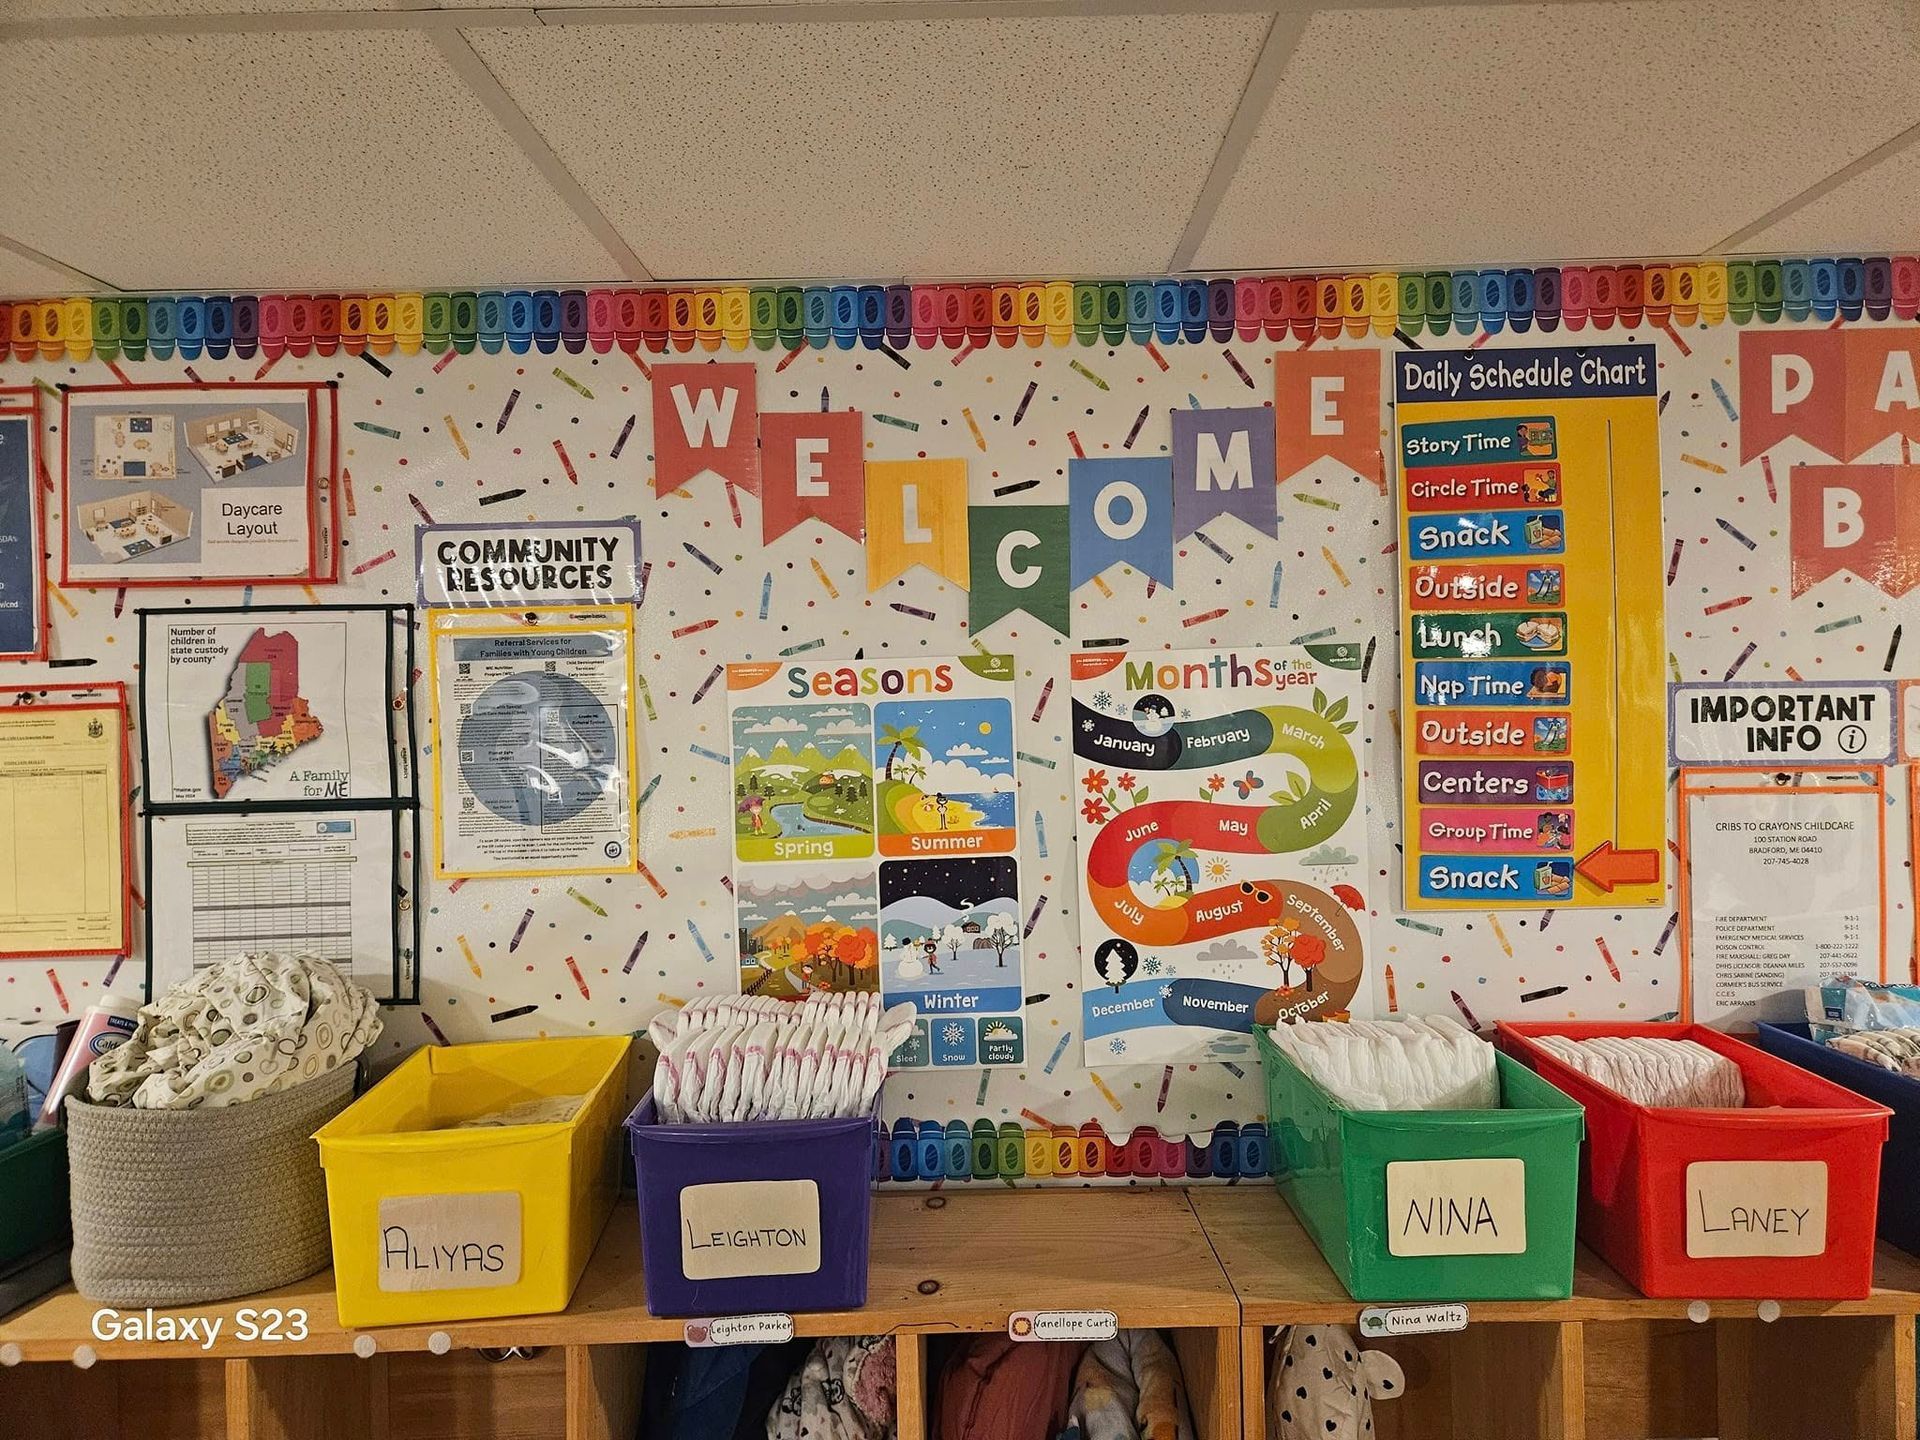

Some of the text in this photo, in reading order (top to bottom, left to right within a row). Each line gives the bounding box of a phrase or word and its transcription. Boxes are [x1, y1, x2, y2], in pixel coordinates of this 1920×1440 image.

[1404, 356, 1647, 397] Daily Schedule Chart
[1406, 433, 1511, 456] Story Time
[1411, 477, 1519, 498] Circle Time
[222, 503, 283, 519] Daycare
[227, 521, 278, 538] Layout
[1418, 520, 1511, 551] Snack
[437, 536, 619, 565] COMMUNITY
[447, 565, 612, 592] RESOURCES
[1415, 568, 1519, 600] Outside
[170, 627, 216, 636] Number of
[170, 637, 216, 645] children in
[526, 638, 559, 646] Services
[1420, 616, 1502, 648] Lunch
[170, 656, 180, 664] by
[194, 646, 229, 655] custody
[480, 650, 512, 658] Families
[531, 649, 555, 657] Young
[556, 648, 587, 656] Children
[787, 663, 954, 699] Seasons
[1125, 653, 1273, 691] Months
[1274, 659, 1287, 671] of
[1292, 658, 1312, 671] the
[1275, 670, 1318, 691] year
[1420, 675, 1524, 697] Nap Time
[1690, 694, 1876, 723] IMPORTANT
[1186, 728, 1251, 749] February
[1281, 723, 1327, 750] March
[1421, 720, 1526, 746] Outside
[1747, 724, 1822, 753] INFO
[1093, 733, 1157, 756] January
[289, 770, 349, 783] A Family
[1423, 770, 1529, 796] Centers
[304, 782, 348, 798] for ME
[1299, 798, 1333, 831] April
[1124, 820, 1159, 842] June
[1219, 818, 1249, 836] May
[1428, 822, 1533, 842] Group Time
[1715, 821, 1855, 831] CRIBS TO CRAYONS CHILDCARE
[774, 839, 834, 856] Spring
[911, 834, 983, 851] Summer
[1749, 847, 1788, 855] BRADFORD,
[1429, 863, 1520, 890] Snack
[1113, 899, 1145, 926] July
[1195, 899, 1244, 923] August
[1286, 893, 1346, 952] September
[924, 993, 979, 1009] Winter
[1091, 997, 1156, 1018] December
[1183, 994, 1249, 1014] November
[1277, 990, 1330, 1023] October
[942, 1054, 966, 1062] Snow
[988, 1052, 1015, 1061] cloudy
[989, 1043, 1013, 1053] Partly
[896, 1055, 918, 1063] Sleet
[1403, 1195, 1499, 1237] NINA
[1697, 1188, 1810, 1237] LANEY
[685, 1218, 808, 1250] LEIGHTON
[383, 1225, 505, 1273] ALIYAS
[710, 1319, 793, 1336] Leighton Parker
[1033, 1317, 1117, 1331] Vanellope Curtis
[1391, 1311, 1462, 1326] Nina Waltz
